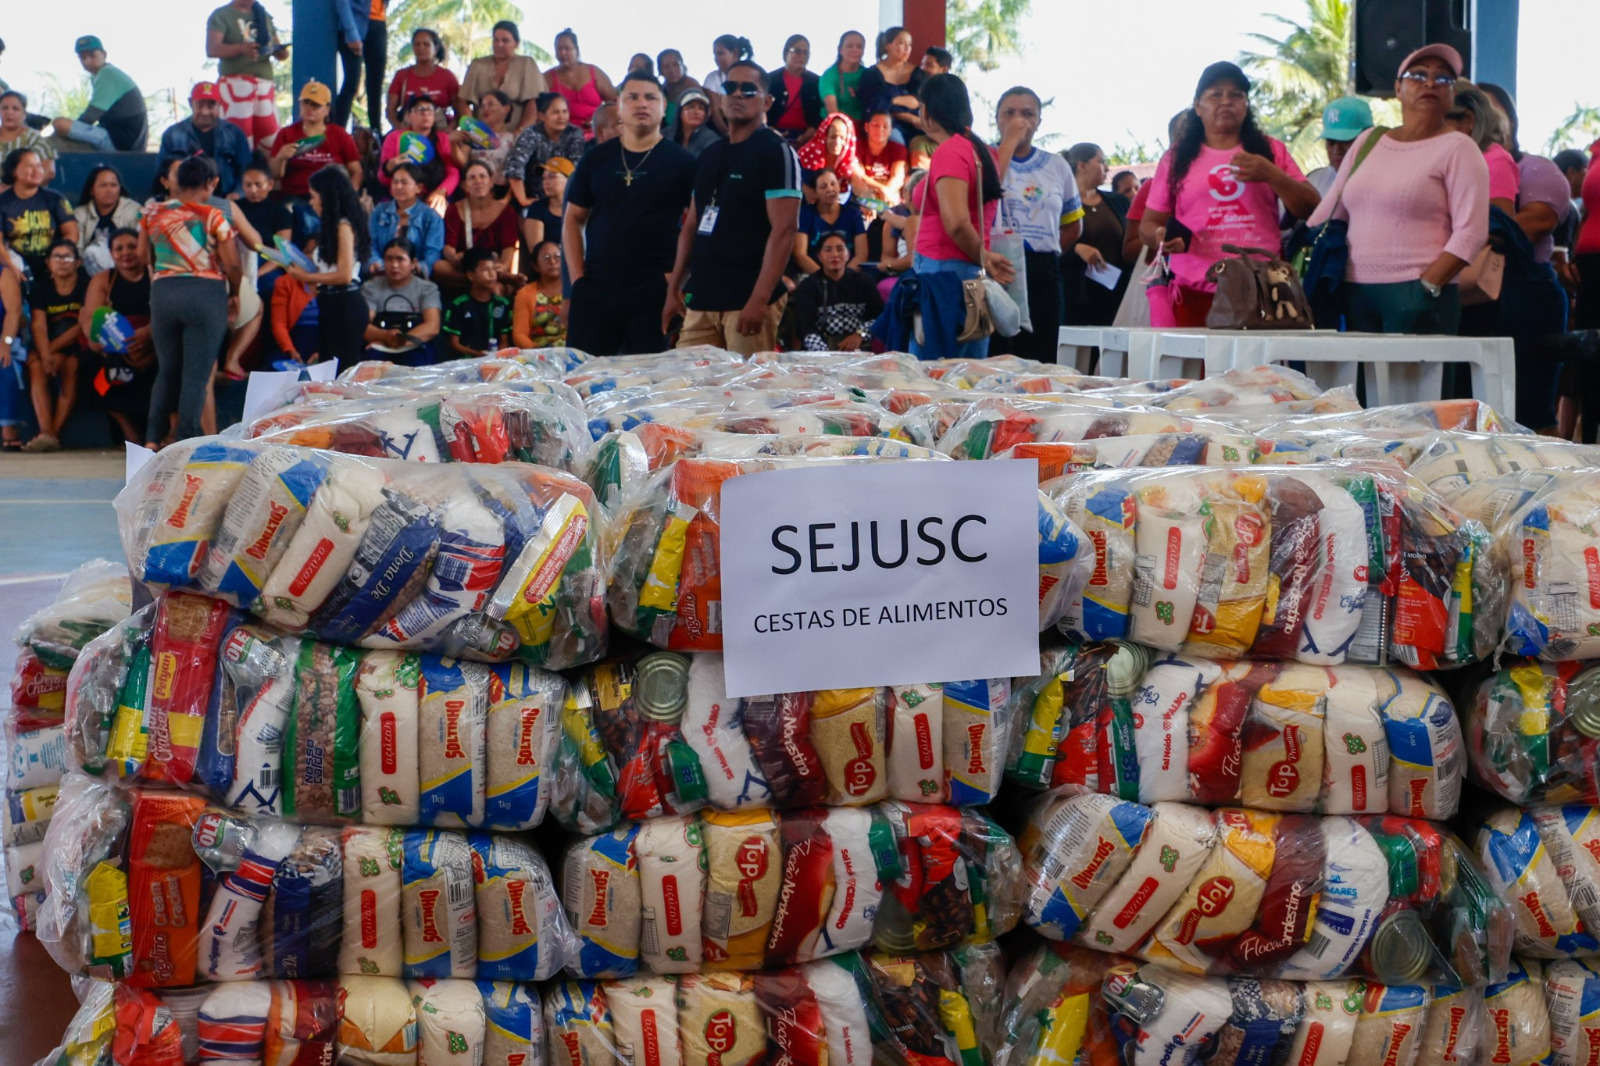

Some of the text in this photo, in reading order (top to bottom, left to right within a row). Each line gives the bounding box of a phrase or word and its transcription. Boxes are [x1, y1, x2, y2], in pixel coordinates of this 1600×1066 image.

[166, 473, 203, 529] SOLTINHO
[246, 500, 288, 560] SOLTINHO
[771, 514, 987, 575] SEJUSC
[296, 546, 326, 587] açúcar
[384, 546, 414, 583] Dona
[1089, 530, 1108, 586] SOLTINHO
[1167, 535, 1178, 584] açúcar
[754, 597, 1008, 633] CESTAS DE ALIMENTOS
[156, 653, 173, 697] Petyan
[152, 708, 174, 762] Cracker
[385, 721, 394, 765] açúcar
[445, 700, 466, 759] SOLTINHO
[517, 708, 540, 766] SOLTINHO
[782, 715, 808, 776] Nordestino
[968, 723, 986, 775] SOLTINHO
[1162, 733, 1172, 759] Moído
[1287, 727, 1299, 762] Premium
[849, 760, 873, 795] Top
[1162, 758, 1170, 771] Sal
[1270, 764, 1297, 796] Top
[431, 794, 445, 805] 1kg
[745, 840, 766, 878] Top
[841, 848, 849, 863] Sal
[1071, 836, 1115, 890] SOLTINHO
[151, 881, 167, 927] Cream
[166, 875, 186, 928] Cracker
[419, 889, 443, 943] SOLTINHO
[507, 880, 532, 936] SOLTINHO
[588, 868, 610, 927] SOLTINHO
[665, 884, 678, 929] açúcar
[768, 876, 797, 950] Nordestino
[1202, 880, 1234, 913] Top
[1281, 881, 1302, 947] ordestino
[709, 1013, 732, 1051] Top
[1490, 1008, 1512, 1064] SOLTINHO
